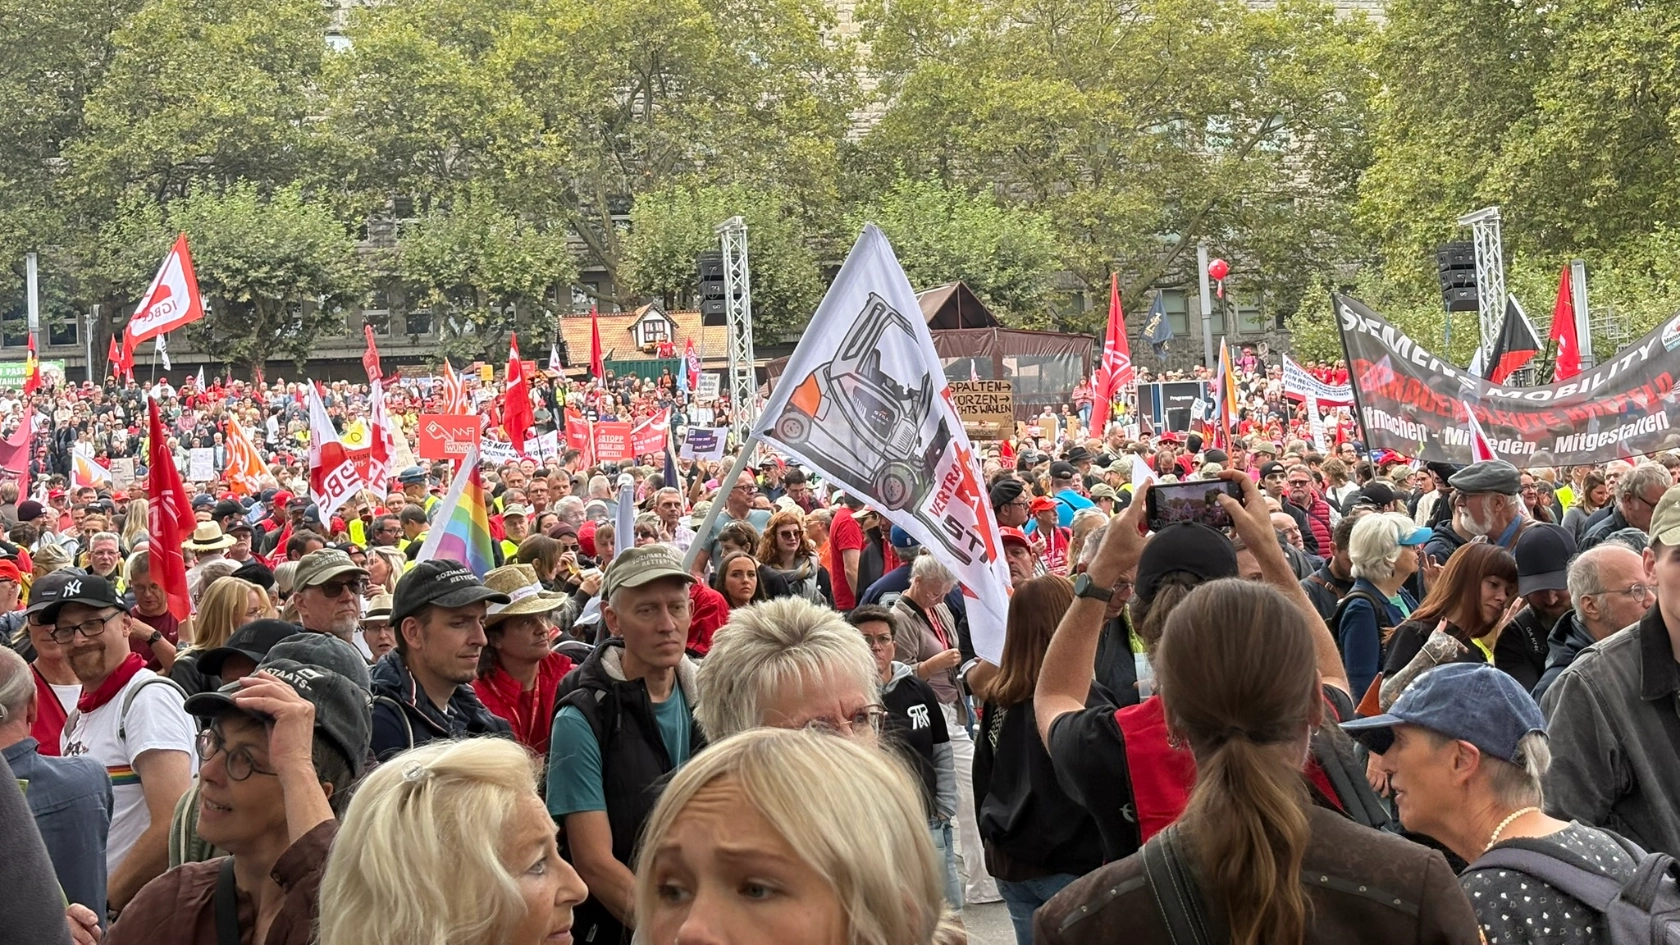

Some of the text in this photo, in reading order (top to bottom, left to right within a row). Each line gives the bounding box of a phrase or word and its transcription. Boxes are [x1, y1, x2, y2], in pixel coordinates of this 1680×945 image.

[1340, 304, 1656, 400] SIEMENS MOBILITY
[948, 381, 1002, 392] SPALTEN
[1361, 406, 1428, 442] itmachen
[1445, 426, 1536, 455] Mieden
[1554, 411, 1670, 454] Mitgestalten
[928, 458, 963, 518] VERTRA
[63, 579, 82, 598] NY
[265, 666, 312, 691] STAATS-
